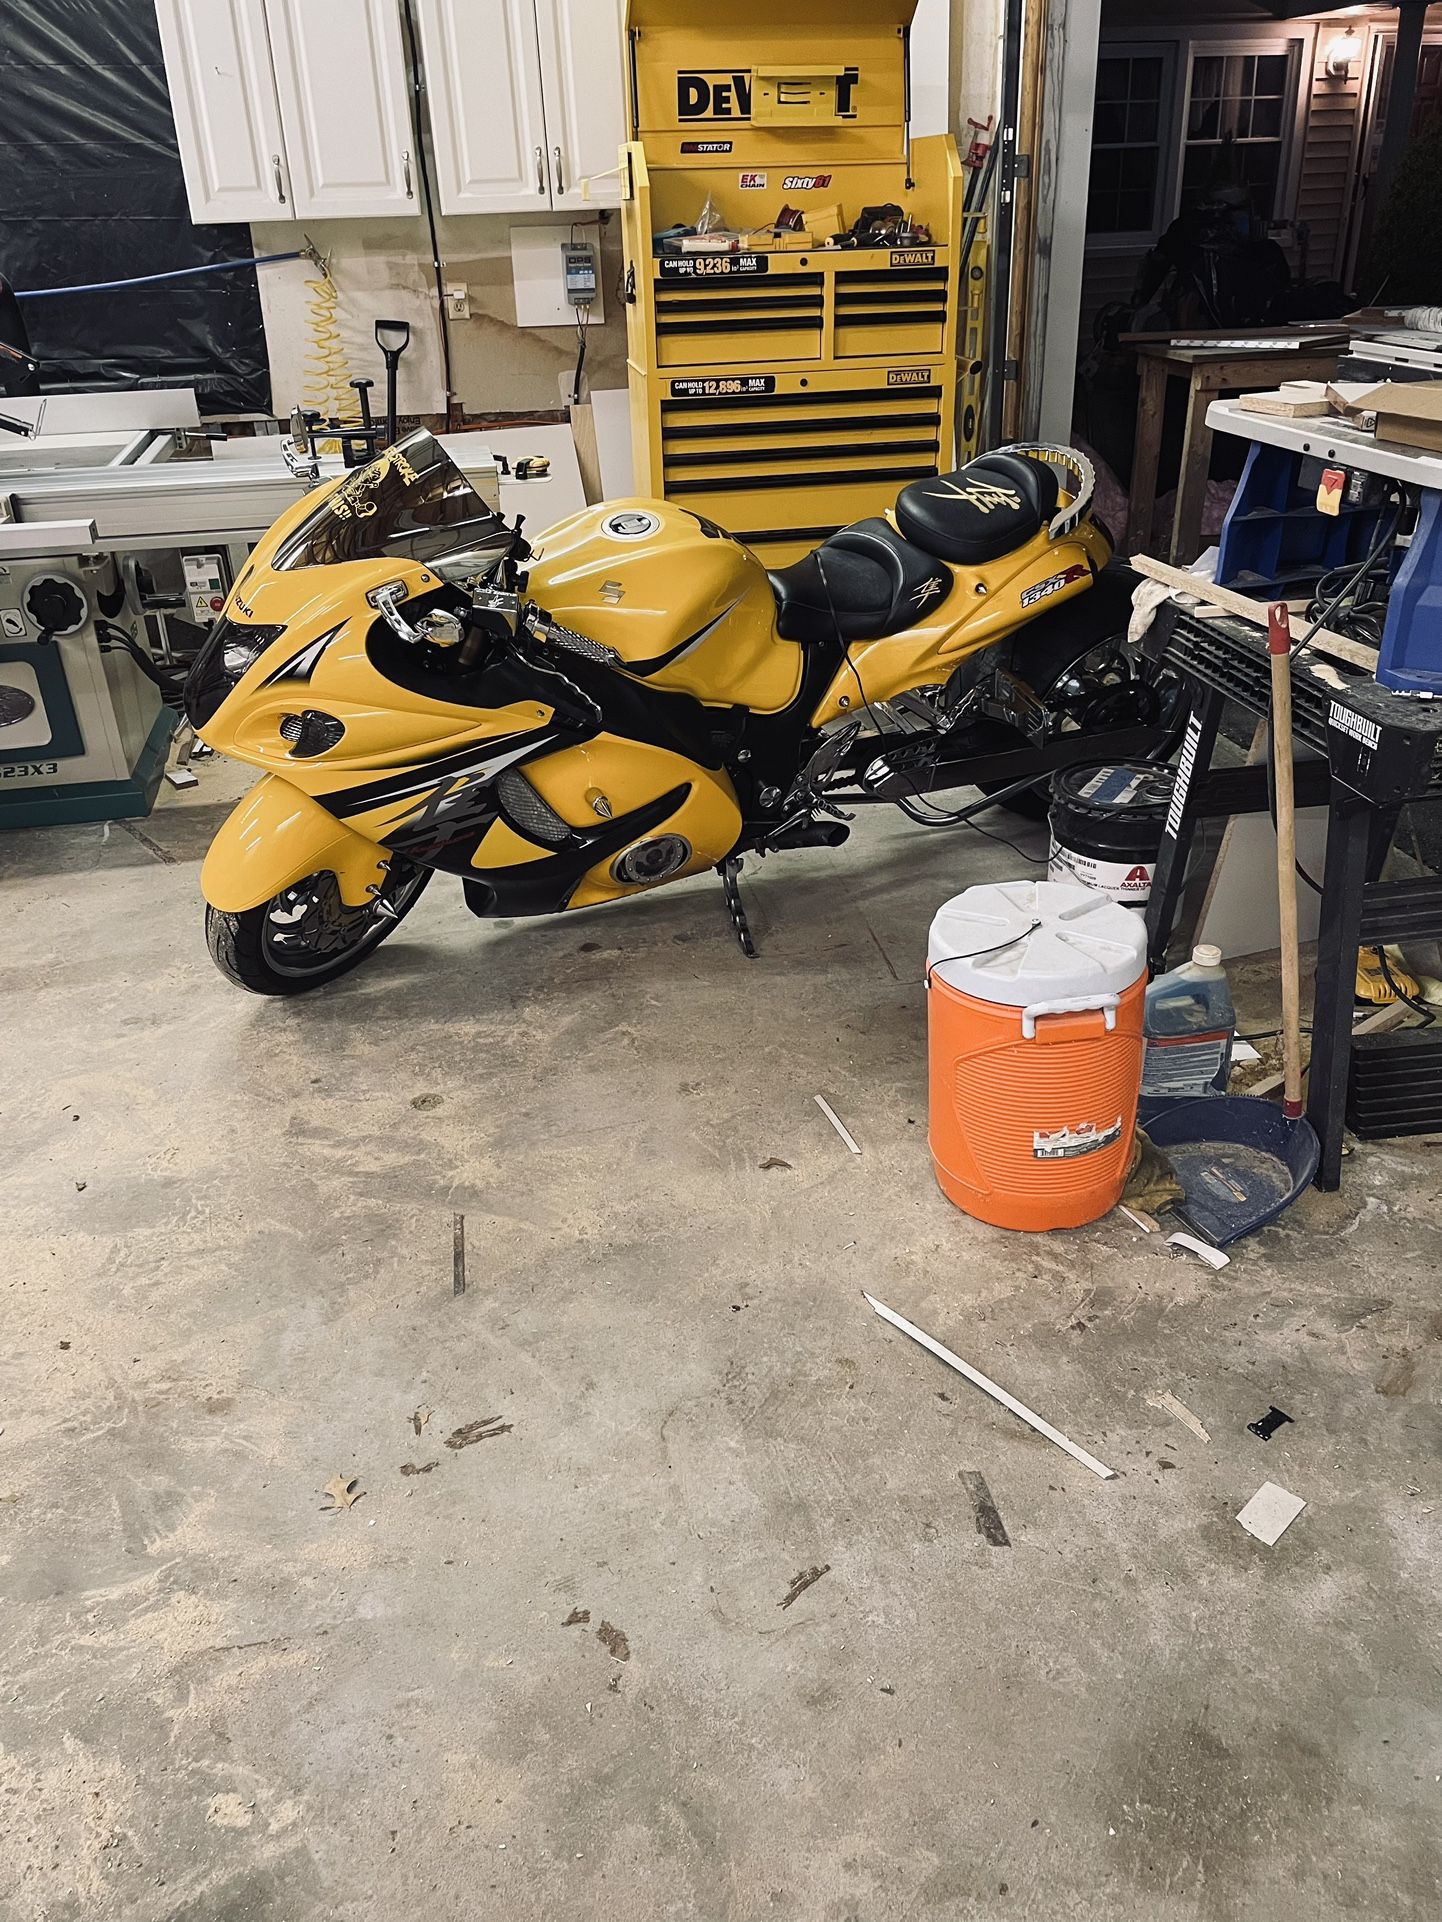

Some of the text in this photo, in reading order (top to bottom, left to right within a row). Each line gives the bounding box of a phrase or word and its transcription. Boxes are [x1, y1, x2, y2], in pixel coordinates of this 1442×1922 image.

[678, 73, 859, 116] DET
[741, 174, 757, 183] EK
[740, 257, 757, 265] MAX
[892, 252, 933, 264] DEWALT
[695, 258, 731, 275] 9,236
[749, 378, 765, 387] MAX
[889, 371, 929, 382] DEWALT
[704, 380, 741, 395] 12,896
[236, 597, 254, 618] ZUKI
[1329, 700, 1382, 742] TOUGHBUILT
[0, 762, 58, 778] 23X3
[1165, 710, 1202, 840] TOUGHBUILT
